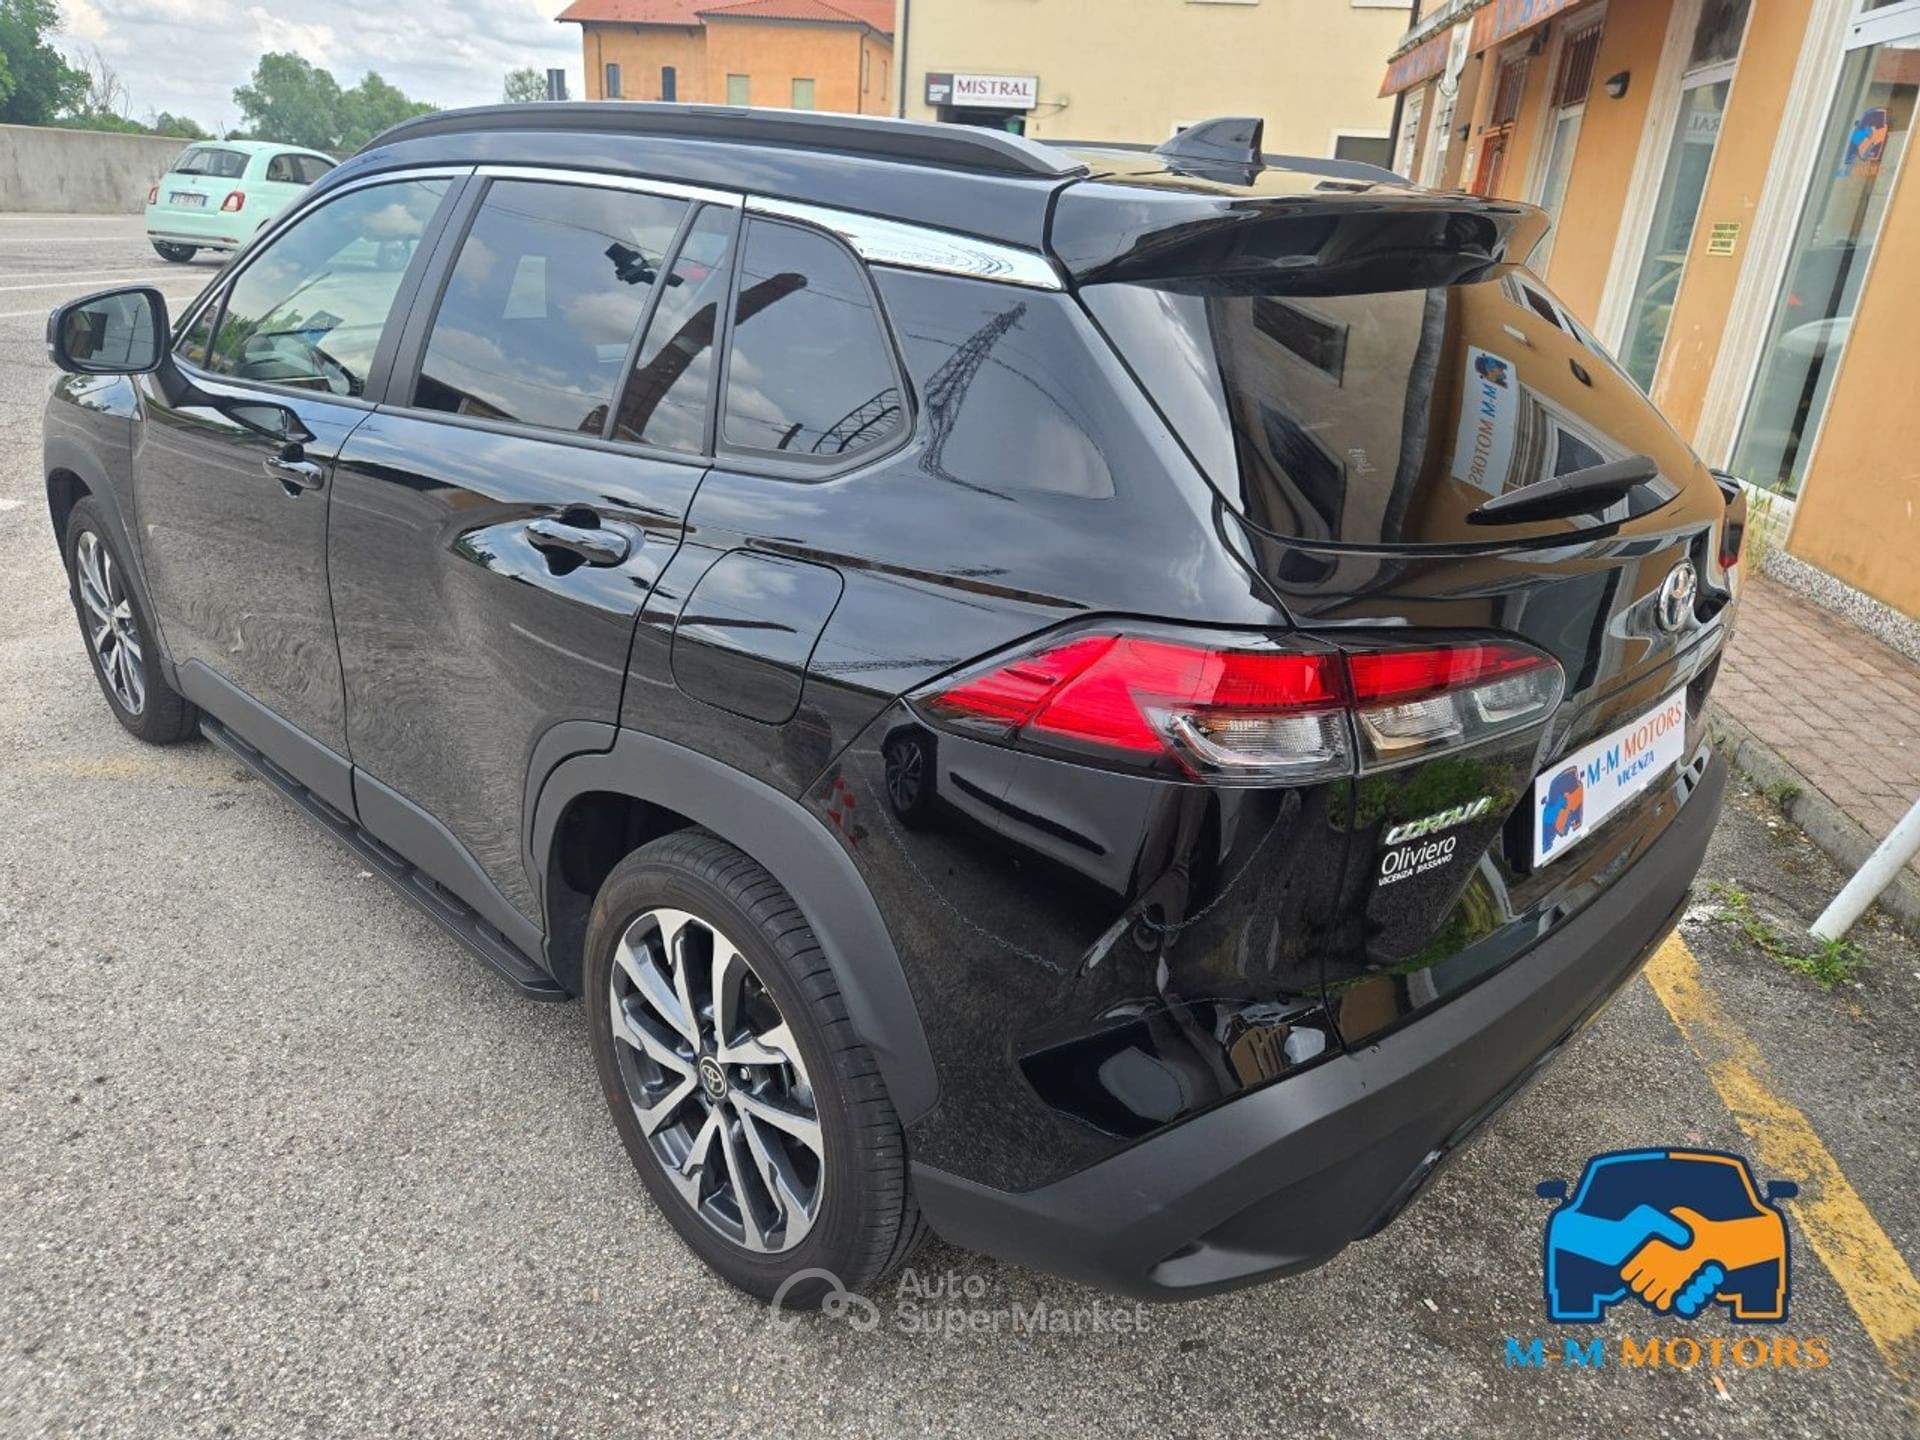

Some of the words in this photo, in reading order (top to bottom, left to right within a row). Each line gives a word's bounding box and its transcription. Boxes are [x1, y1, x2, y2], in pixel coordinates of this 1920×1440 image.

[957, 79, 1032, 96] MISTRAL
[1587, 744, 1621, 789] M-M
[1624, 700, 1683, 760] MOTORS
[1616, 750, 1655, 788] VICENZA
[1381, 836, 1456, 875] Oliviero
[1378, 868, 1413, 887] VICENZA
